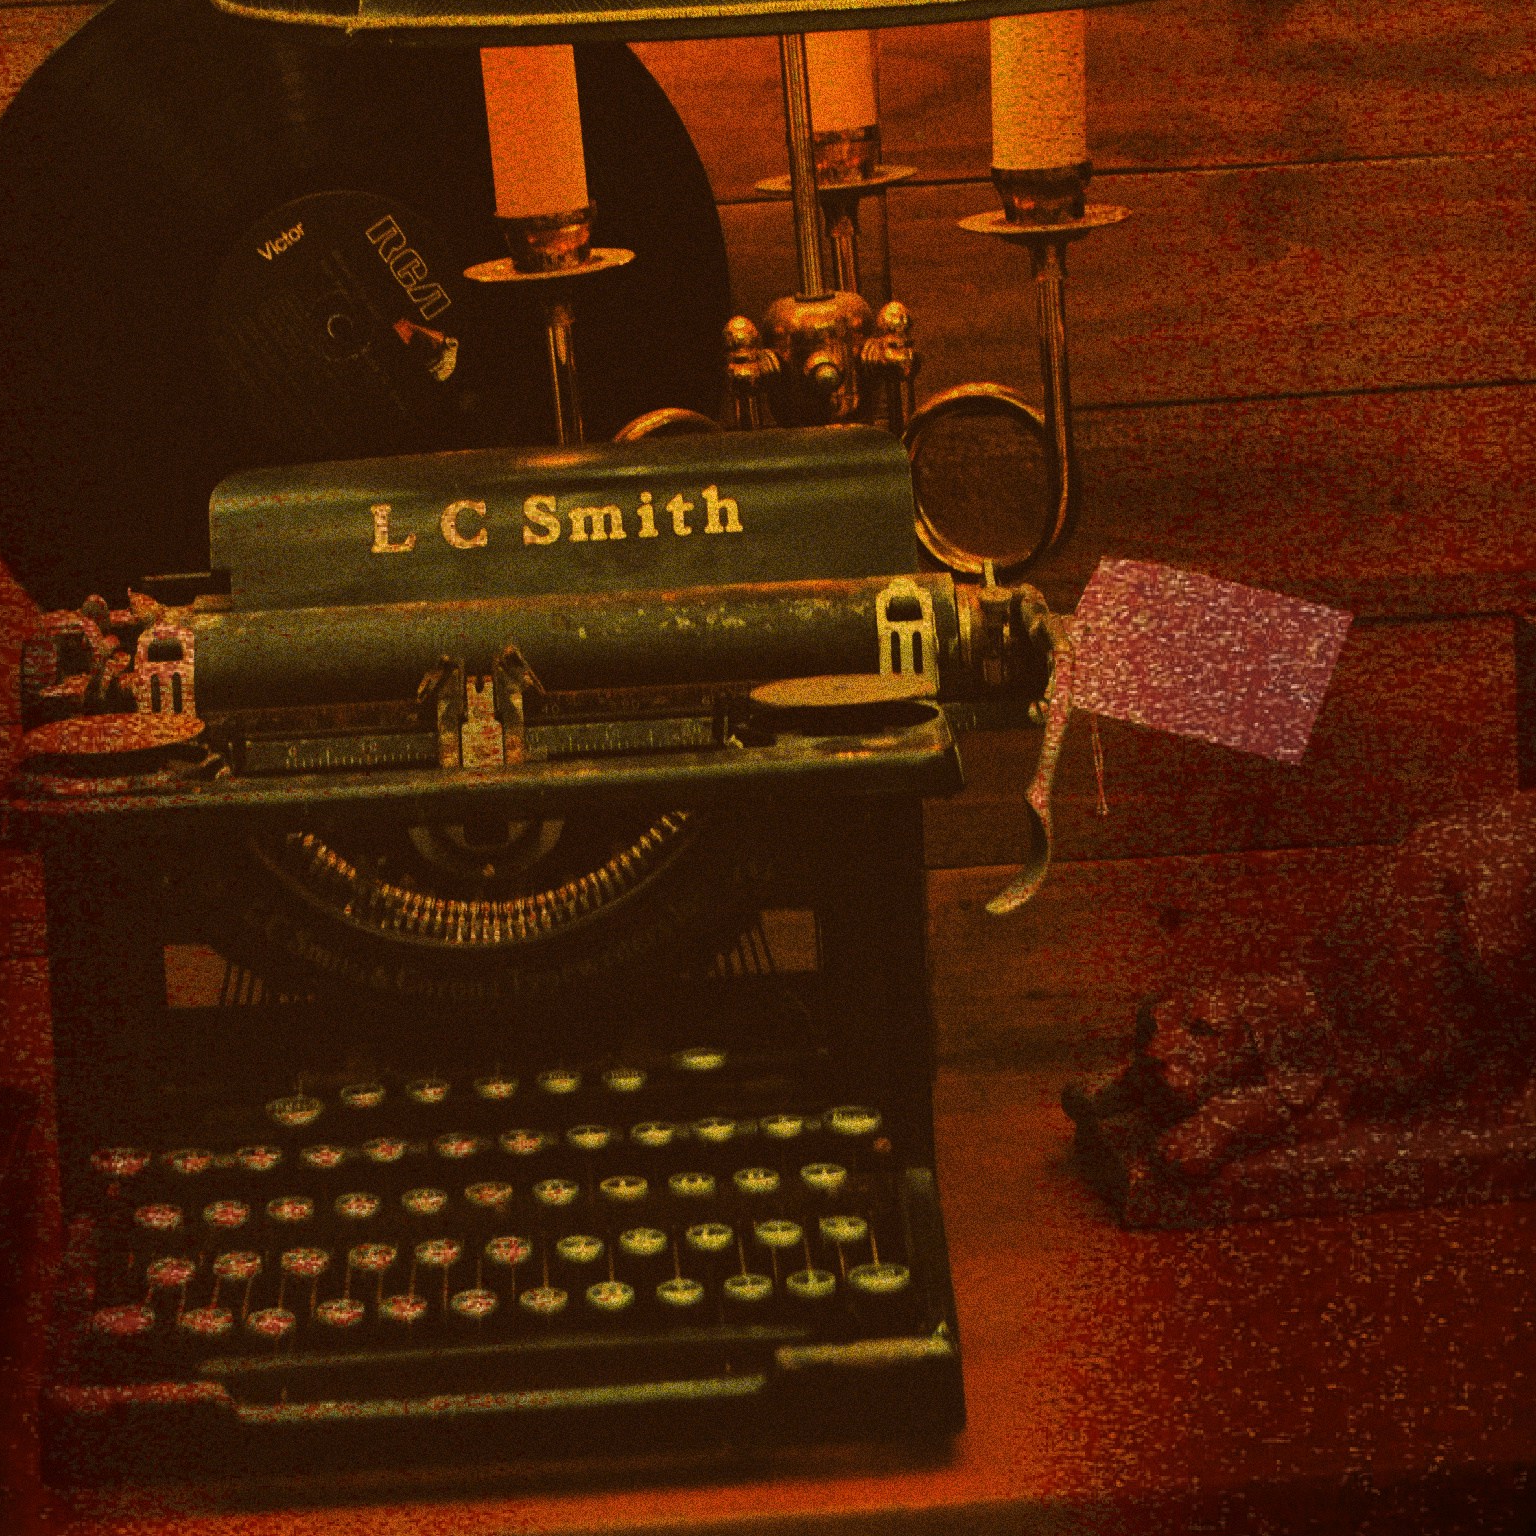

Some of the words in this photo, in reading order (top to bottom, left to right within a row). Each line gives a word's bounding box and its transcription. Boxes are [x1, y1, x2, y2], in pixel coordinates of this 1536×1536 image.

[257, 222, 305, 261] Victor
[365, 215, 452, 321] RCA
[369, 503, 416, 554] L
[440, 500, 488, 549] C
[523, 484, 744, 546] Smith
